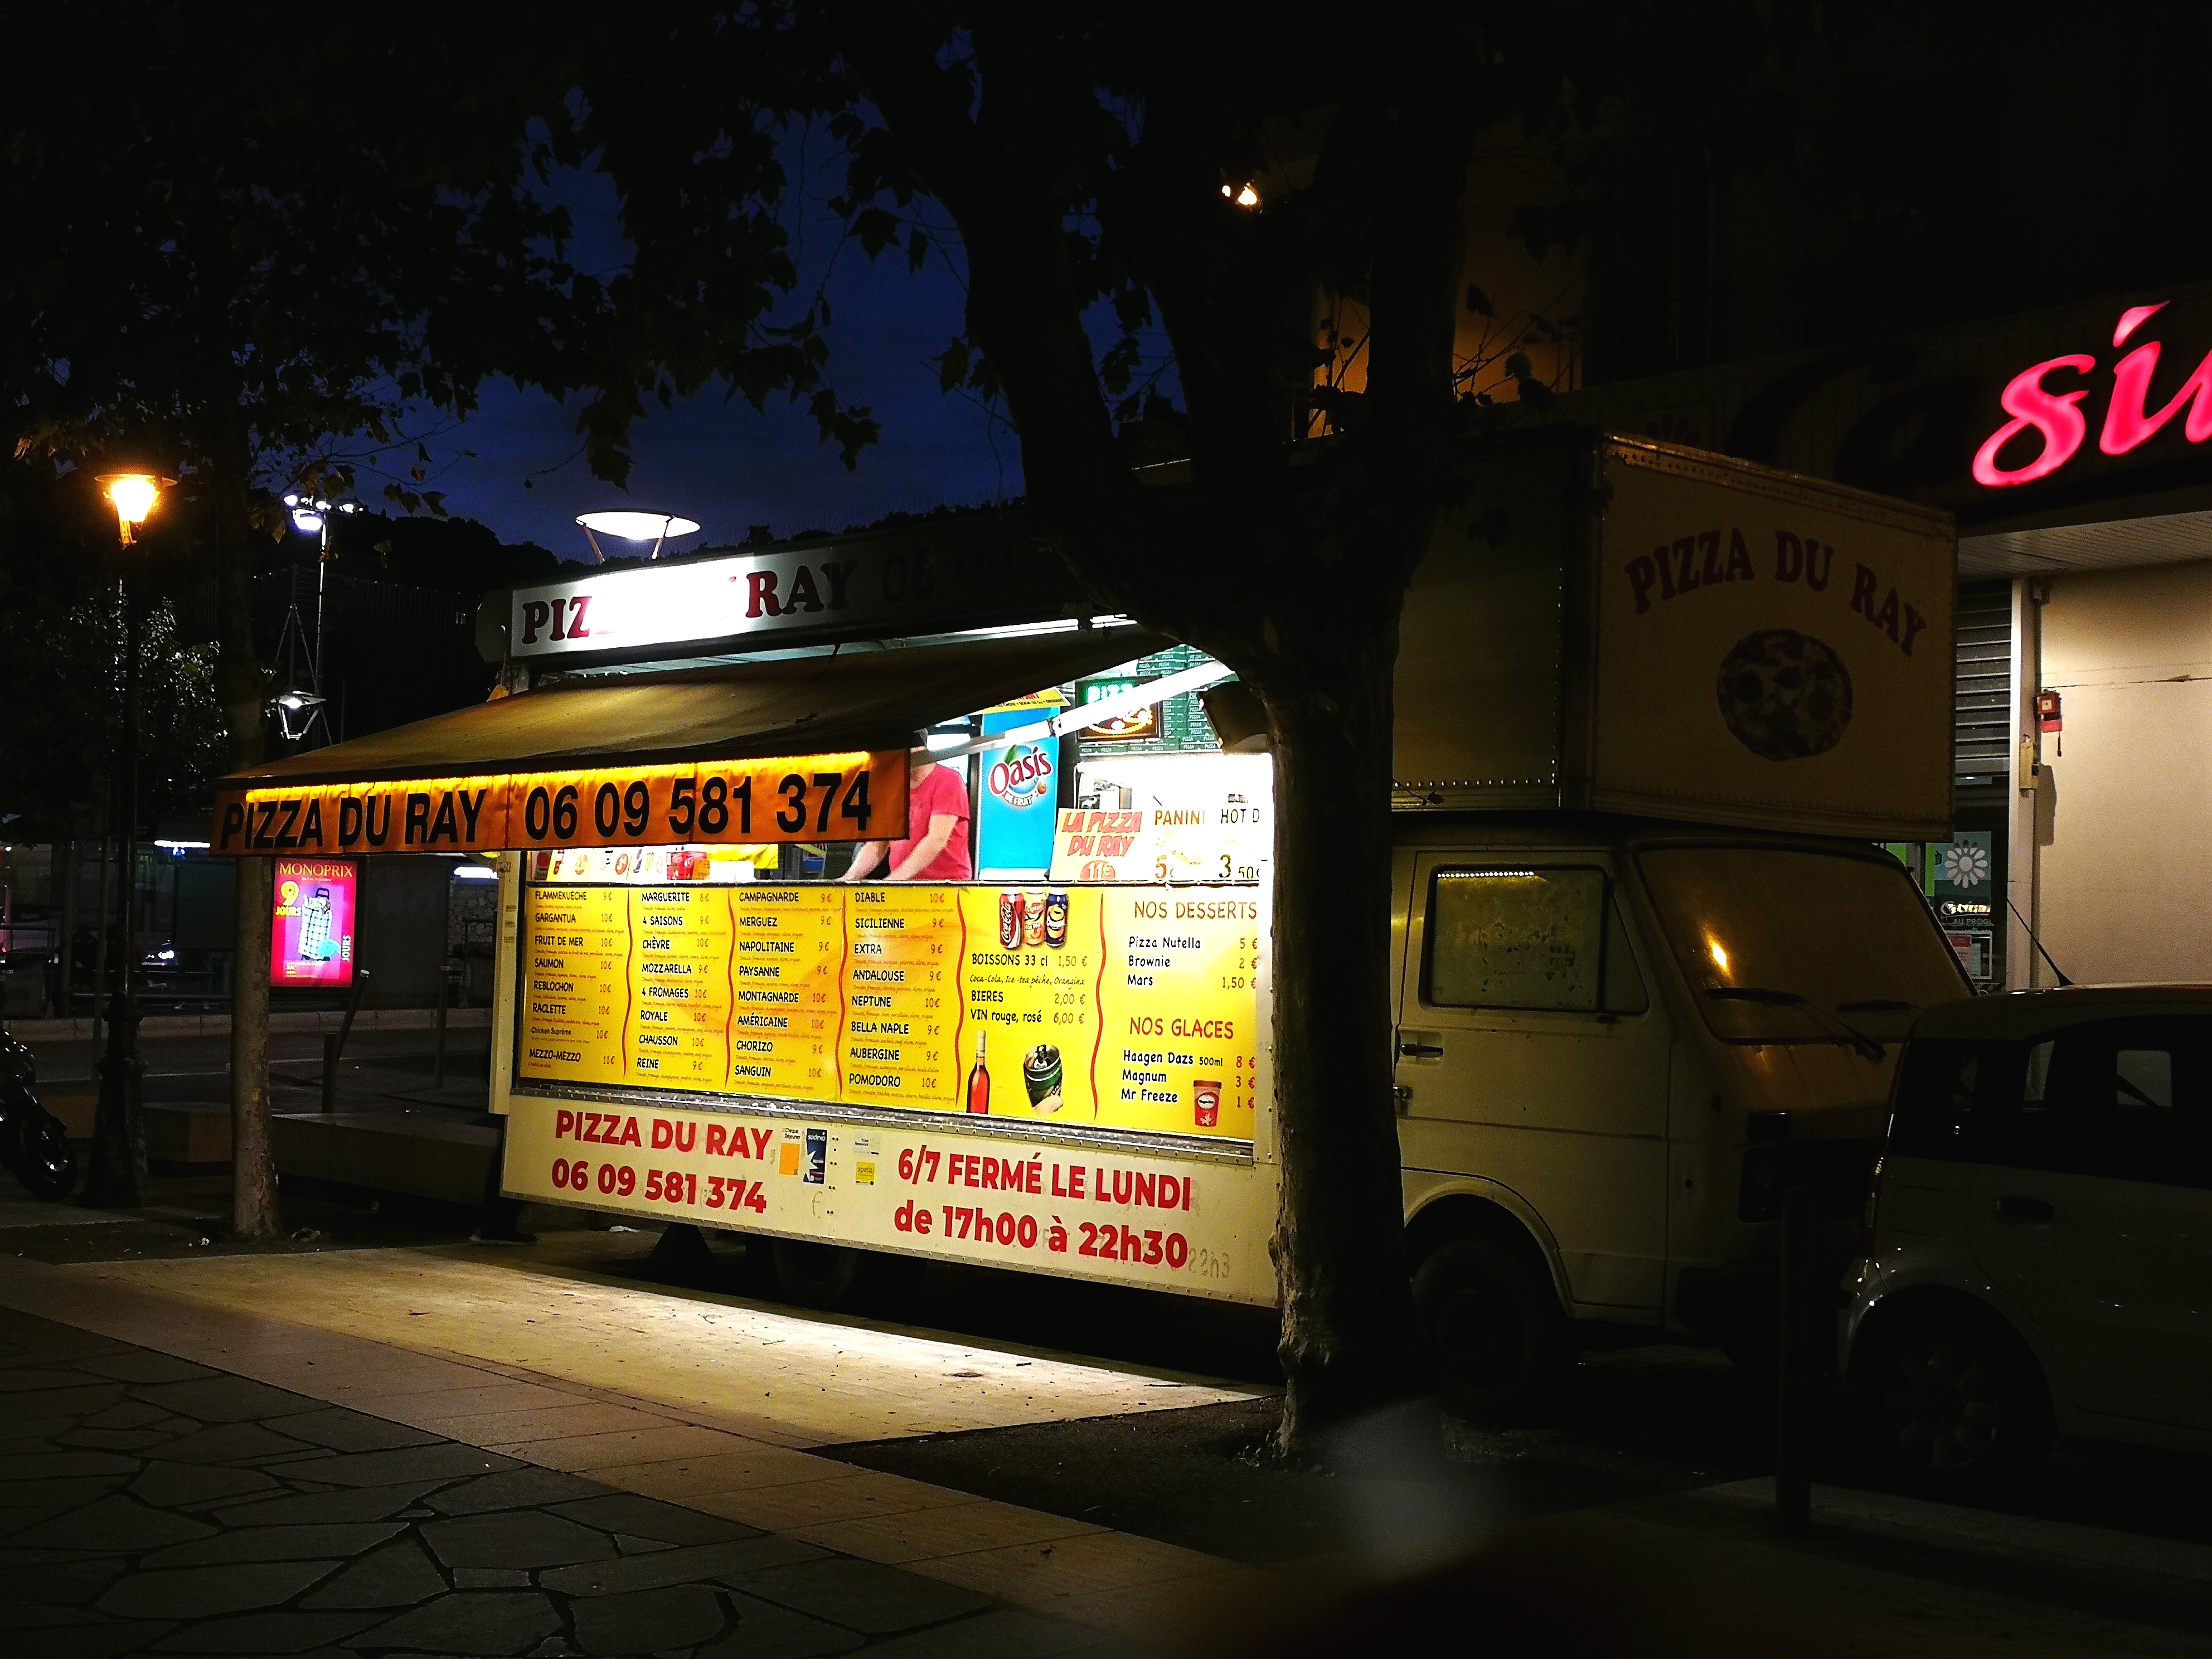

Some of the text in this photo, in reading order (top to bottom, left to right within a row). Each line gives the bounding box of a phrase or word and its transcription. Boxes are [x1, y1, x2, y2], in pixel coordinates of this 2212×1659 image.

[1624, 528, 1927, 657] PIZZA DU RAY
[989, 746, 1052, 794] Oasis
[1013, 794, 1033, 807] FRUIT
[220, 770, 872, 850] PIZZA DU RAY 06 09 581 374
[1221, 808, 1246, 824] HOT
[1062, 811, 1143, 833] LA PIZZA
[1154, 810, 1205, 826] PANINI
[1067, 836, 1135, 857] DU RAY
[279, 862, 353, 878] MONOPRIX
[280, 881, 300, 906] 9
[535, 890, 587, 900] FLAMMEKUECHE
[642, 891, 690, 902] MARGUERITE
[739, 891, 799, 902] CAMPAGNARDE
[855, 892, 885, 903] DIABLE
[275, 906, 302, 917] JOURS
[1134, 901, 1257, 919] NOS DESSERTS
[535, 913, 576, 923] GARGANTUA
[643, 915, 683, 925] 4 SAISONS
[739, 916, 778, 927] MERGUEZ
[855, 918, 905, 929] SICILIENNE
[535, 935, 584, 947] FRUIT DE MER
[642, 936, 670, 949] CHÈVRE
[739, 941, 794, 953] NAPOLITAINE
[1129, 935, 1258, 949] Pizza Nutella 5 €
[342, 935, 351, 962] JOURS
[854, 943, 882, 954] EXTRA
[535, 958, 564, 968] SAUMON
[972, 953, 1087, 968] BOISSONS 33 cl 1,50 €
[1128, 955, 1171, 967] Brownie
[1239, 958, 1245, 969] 2
[642, 963, 692, 974] MOZZARELLA
[739, 965, 780, 977] PAYSANNE
[852, 969, 905, 982] ANDALOUSE
[533, 980, 574, 992] REBLOCHON
[969, 973, 1003, 984] Coca-Cola,
[1054, 976, 1084, 989] Orangina
[1127, 974, 1153, 986] Mars
[1222, 977, 1244, 990] 1,50
[642, 986, 689, 998] 4 FROMAGES
[738, 991, 799, 1003] MONTAGNARDE
[971, 989, 1085, 1006] BIERES 2,00 €
[852, 995, 892, 1007] NEPTUNE
[532, 1002, 566, 1015] RACLETTE
[641, 1010, 668, 1021] ROYALE
[737, 1012, 788, 1028] AMÉRICAINE
[971, 1008, 1084, 1026] VIN rouge, rosé 6,00 €
[851, 1021, 909, 1035] BELLA NAPLE
[1130, 1017, 1234, 1040] NOS GLACES
[639, 1034, 678, 1046] CHAUSSON
[736, 1040, 773, 1052] CHORIZO
[529, 1048, 581, 1063] MEZZO-MEZZO
[850, 1047, 900, 1061] AUBERGINE
[1123, 1050, 1162, 1066] Haagen
[1167, 1052, 1194, 1065] Dazs
[1199, 1056, 1223, 1067] 500ml
[1236, 1055, 1243, 1068] 8
[637, 1057, 659, 1069] REINE
[735, 1065, 772, 1077] SANGUIN
[849, 1073, 901, 1088] POMODORO
[1122, 1069, 1167, 1085] Magnum
[1235, 1075, 1242, 1088] 3
[1121, 1088, 1137, 1100] Mr
[1141, 1089, 1177, 1103] Freeze
[1236, 1096, 1241, 1108] 1
[555, 1109, 774, 1160] PIZZA DU RAY
[898, 1144, 1191, 1211] 6/7 FERMÉ LE LUNDI
[552, 1158, 767, 1214] 06 09 581 374
[894, 1199, 1189, 1269] de 17h00 à 22h30
